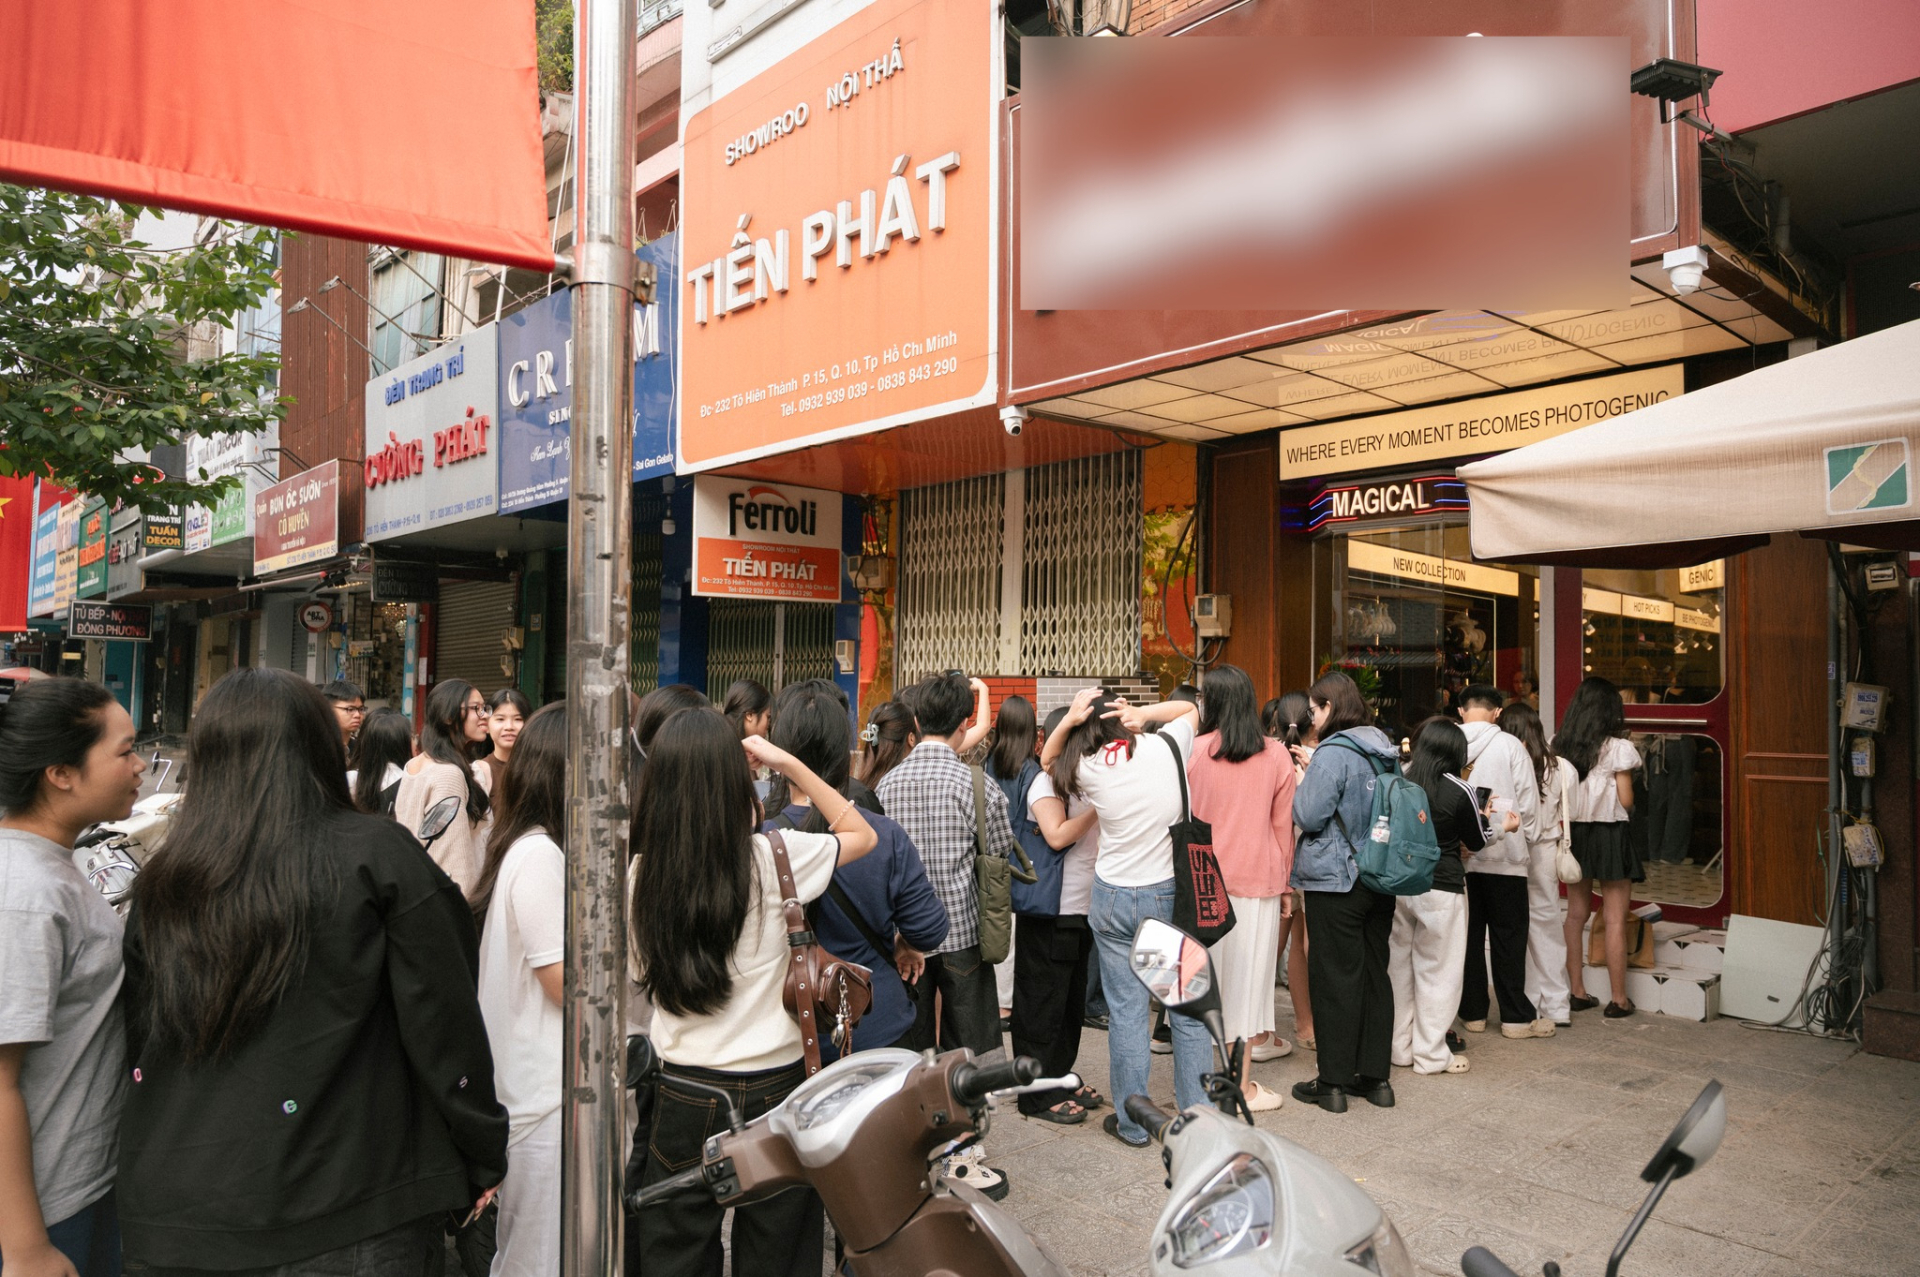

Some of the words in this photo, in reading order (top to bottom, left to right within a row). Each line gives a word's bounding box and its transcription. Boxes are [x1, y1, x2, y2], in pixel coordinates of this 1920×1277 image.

[725, 102, 809, 166] SHOWROO
[827, 72, 860, 110] NỘI
[687, 213, 789, 324] TIẾN
[802, 151, 960, 281] PHÁT
[385, 377, 405, 406] ĐÈN
[407, 363, 443, 396] TRANG
[445, 345, 464, 379] TRÍ
[715, 398, 731, 413] 232
[767, 378, 798, 397] Thành
[803, 373, 810, 387] P.
[813, 368, 828, 384] 15,
[831, 364, 842, 379] Q.
[845, 359, 861, 375] 10,
[883, 343, 900, 365] Hồ
[926, 330, 957, 353] Minh
[799, 393, 823, 412] 0932
[826, 387, 845, 406] 939
[847, 381, 867, 400] 039
[877, 370, 905, 392] 0838
[909, 363, 931, 384] 843
[934, 356, 957, 377] 290
[364, 430, 424, 489] CƯỜNG
[433, 405, 490, 468] PHÁT
[1286, 441, 1336, 465] WHERE
[1340, 434, 1385, 457] EVERY
[1388, 423, 1454, 450] MOMENT
[1459, 411, 1540, 439] BECOMES
[299, 479, 321, 505] SƯỜN
[1331, 481, 1431, 517] MAGICAL
[729, 492, 817, 536] Ferroli
[146, 536, 181, 546] DECOR
[150, 525, 178, 536] TUẤN
[742, 543, 776, 552] SHOWROOM
[722, 551, 767, 577] TIẾN
[770, 560, 818, 580] PHÁT
[1393, 557, 1413, 573] NEW
[1415, 561, 1466, 582] COLLECTION
[1688, 568, 1714, 585] GENIC
[75, 604, 87, 619] TỦ
[88, 606, 105, 620] BẾP
[1633, 601, 1644, 613] HOT
[1645, 603, 1661, 615] PICKS
[1682, 613, 1689, 623] BE
[106, 624, 146, 637] PHƯƠNG
[283, 1099, 297, 1114] G
